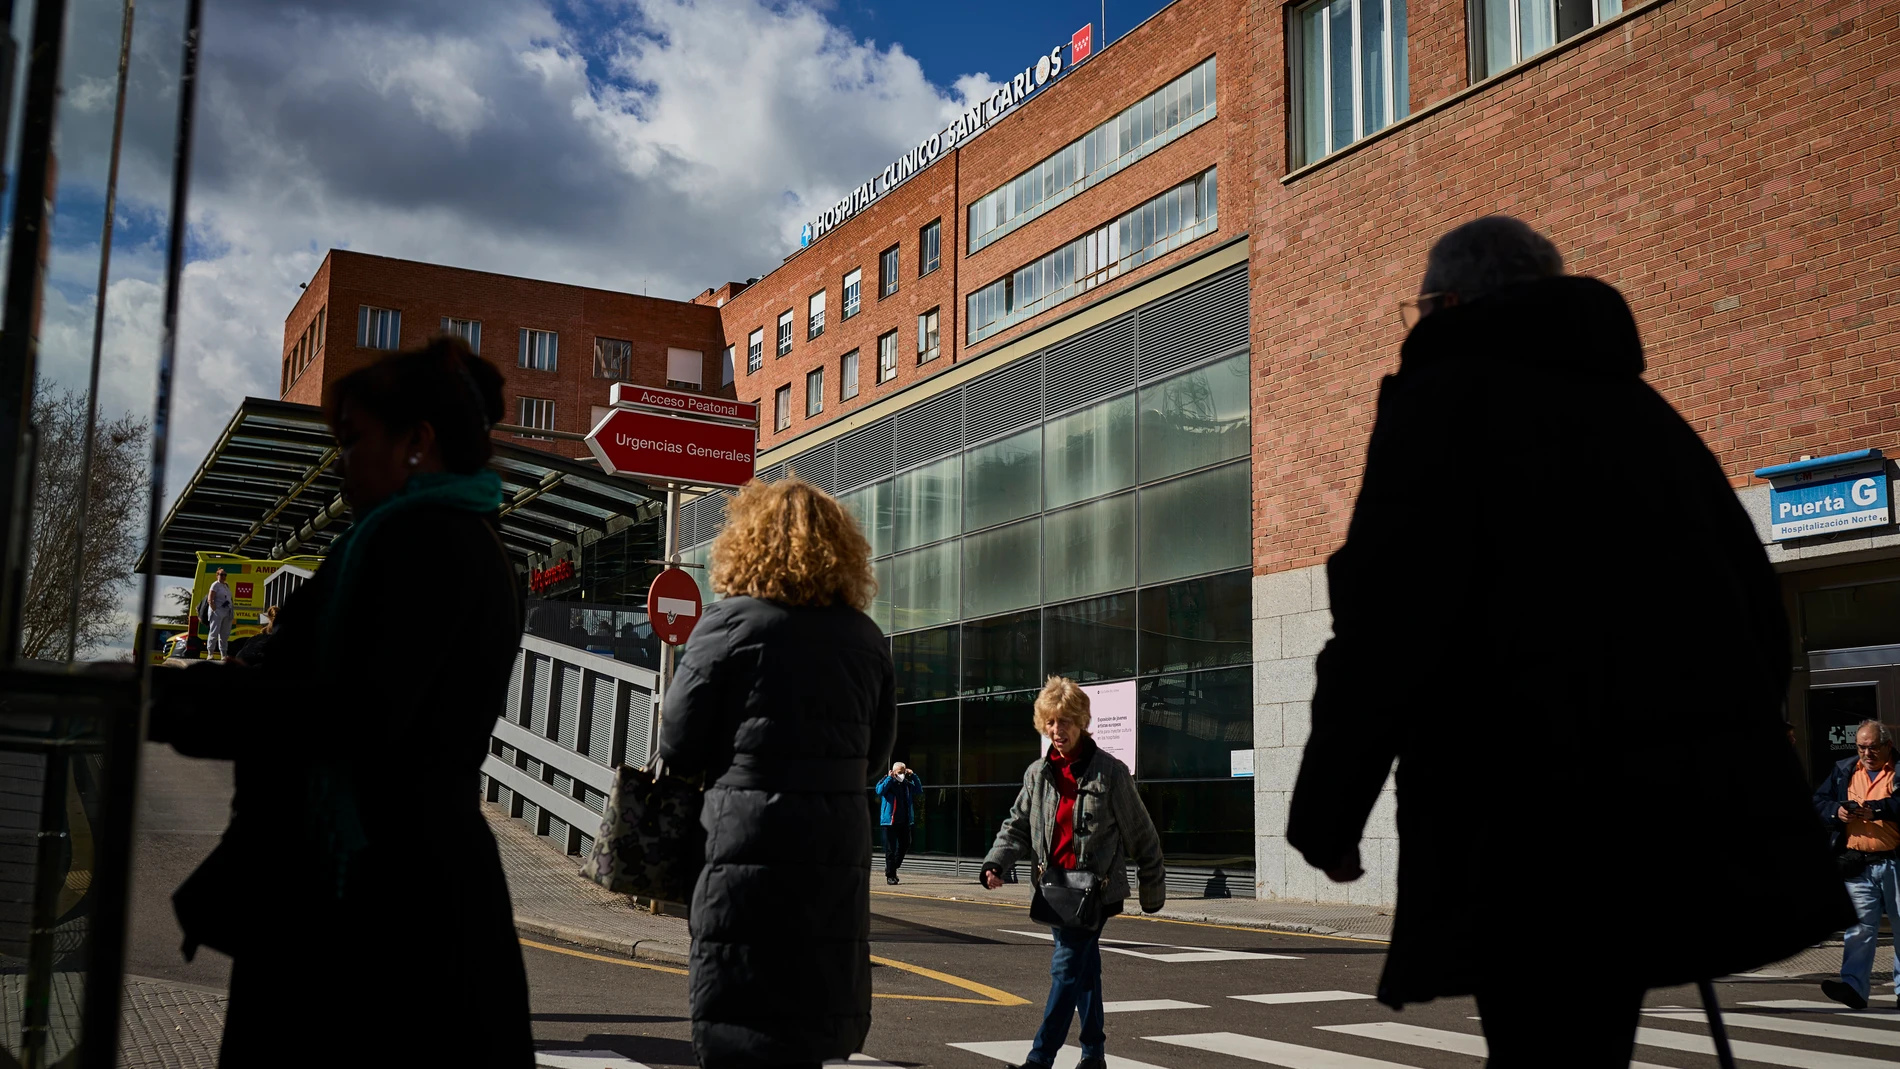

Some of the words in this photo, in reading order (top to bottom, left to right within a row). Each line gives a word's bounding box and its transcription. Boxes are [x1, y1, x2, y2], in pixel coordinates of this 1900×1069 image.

[815, 178, 878, 238] HOSPITAL
[883, 133, 943, 191] CLINICO
[947, 103, 985, 148] SAN
[989, 46, 1062, 117] CARLOS
[641, 391, 685, 408] Acceso
[688, 399, 738, 416] Peatonal
[616, 432, 683, 454] Urgencias
[686, 443, 751, 463] Generales
[1780, 495, 1845, 519] Puerta
[1852, 478, 1877, 506] G
[1781, 516, 1849, 535] Hospitalización
[1852, 514, 1878, 523] Norte
